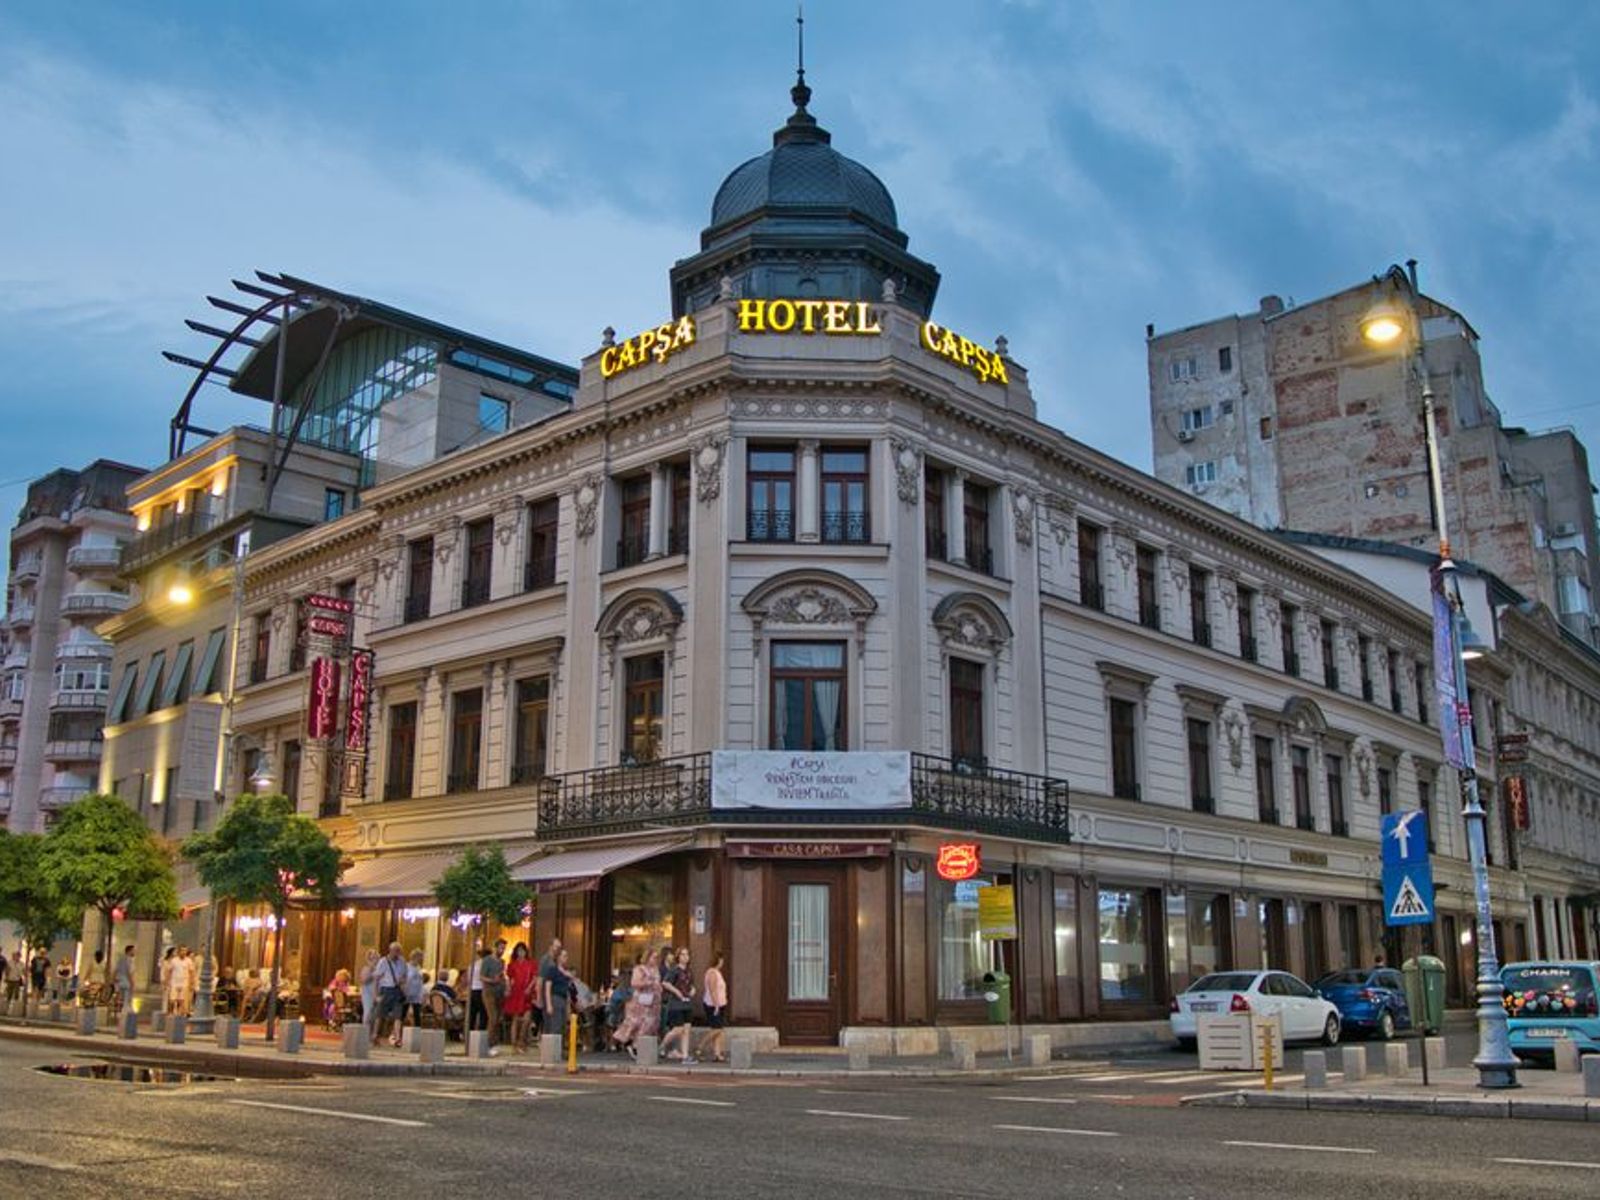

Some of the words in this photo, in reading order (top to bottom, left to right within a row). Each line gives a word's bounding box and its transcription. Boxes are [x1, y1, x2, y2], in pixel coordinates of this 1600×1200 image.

[737, 299, 882, 335] HOTEL
[316, 657, 333, 738] HOTEL
[773, 844, 803, 856] CASA
